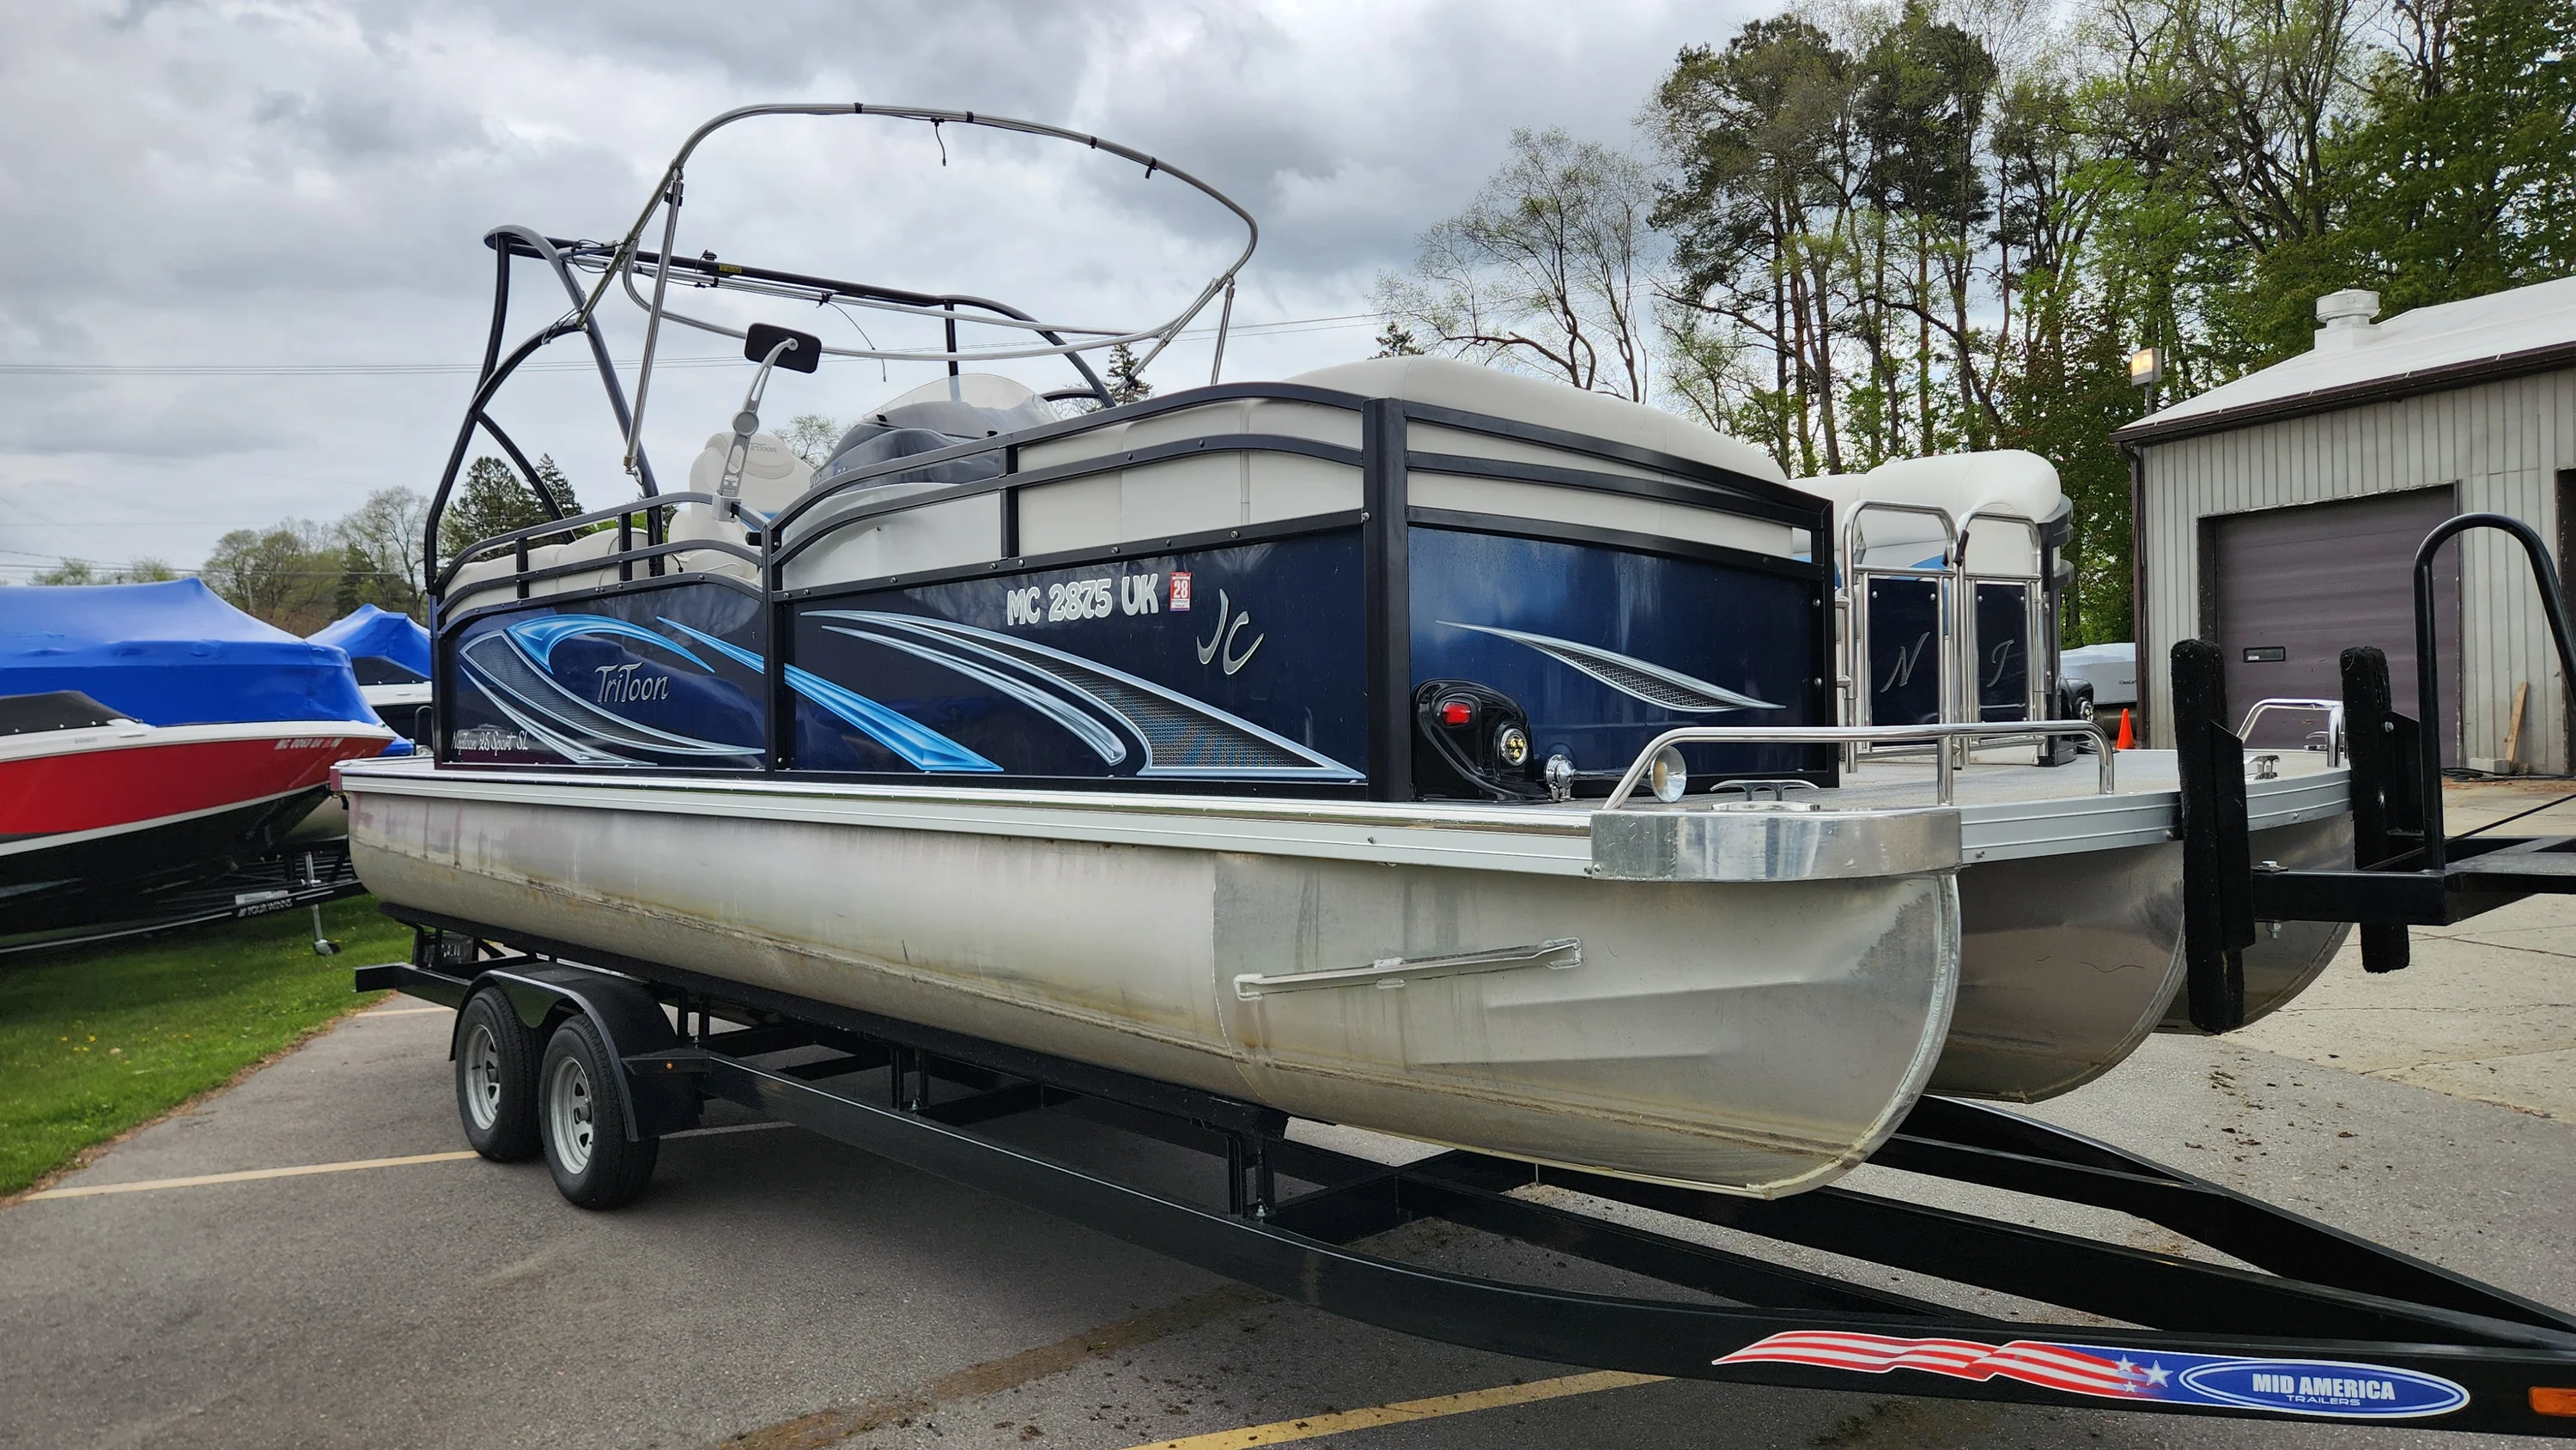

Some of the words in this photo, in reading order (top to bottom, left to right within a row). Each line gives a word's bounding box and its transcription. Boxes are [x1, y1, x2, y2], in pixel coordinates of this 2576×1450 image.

[1006, 586, 1041, 626] MC
[1048, 578, 1113, 622] 2875
[1121, 573, 1159, 616] UK
[1173, 579, 1188, 599] 28
[1880, 631, 1931, 694] N
[594, 661, 670, 703] TriToon
[478, 731, 491, 751] 25
[491, 731, 517, 756] Sport
[516, 730, 530, 750] SL
[2252, 1373, 2294, 1394] MID
[2298, 1376, 2396, 1401] AMERICA
[2286, 1394, 2360, 1406] TRAILERS
